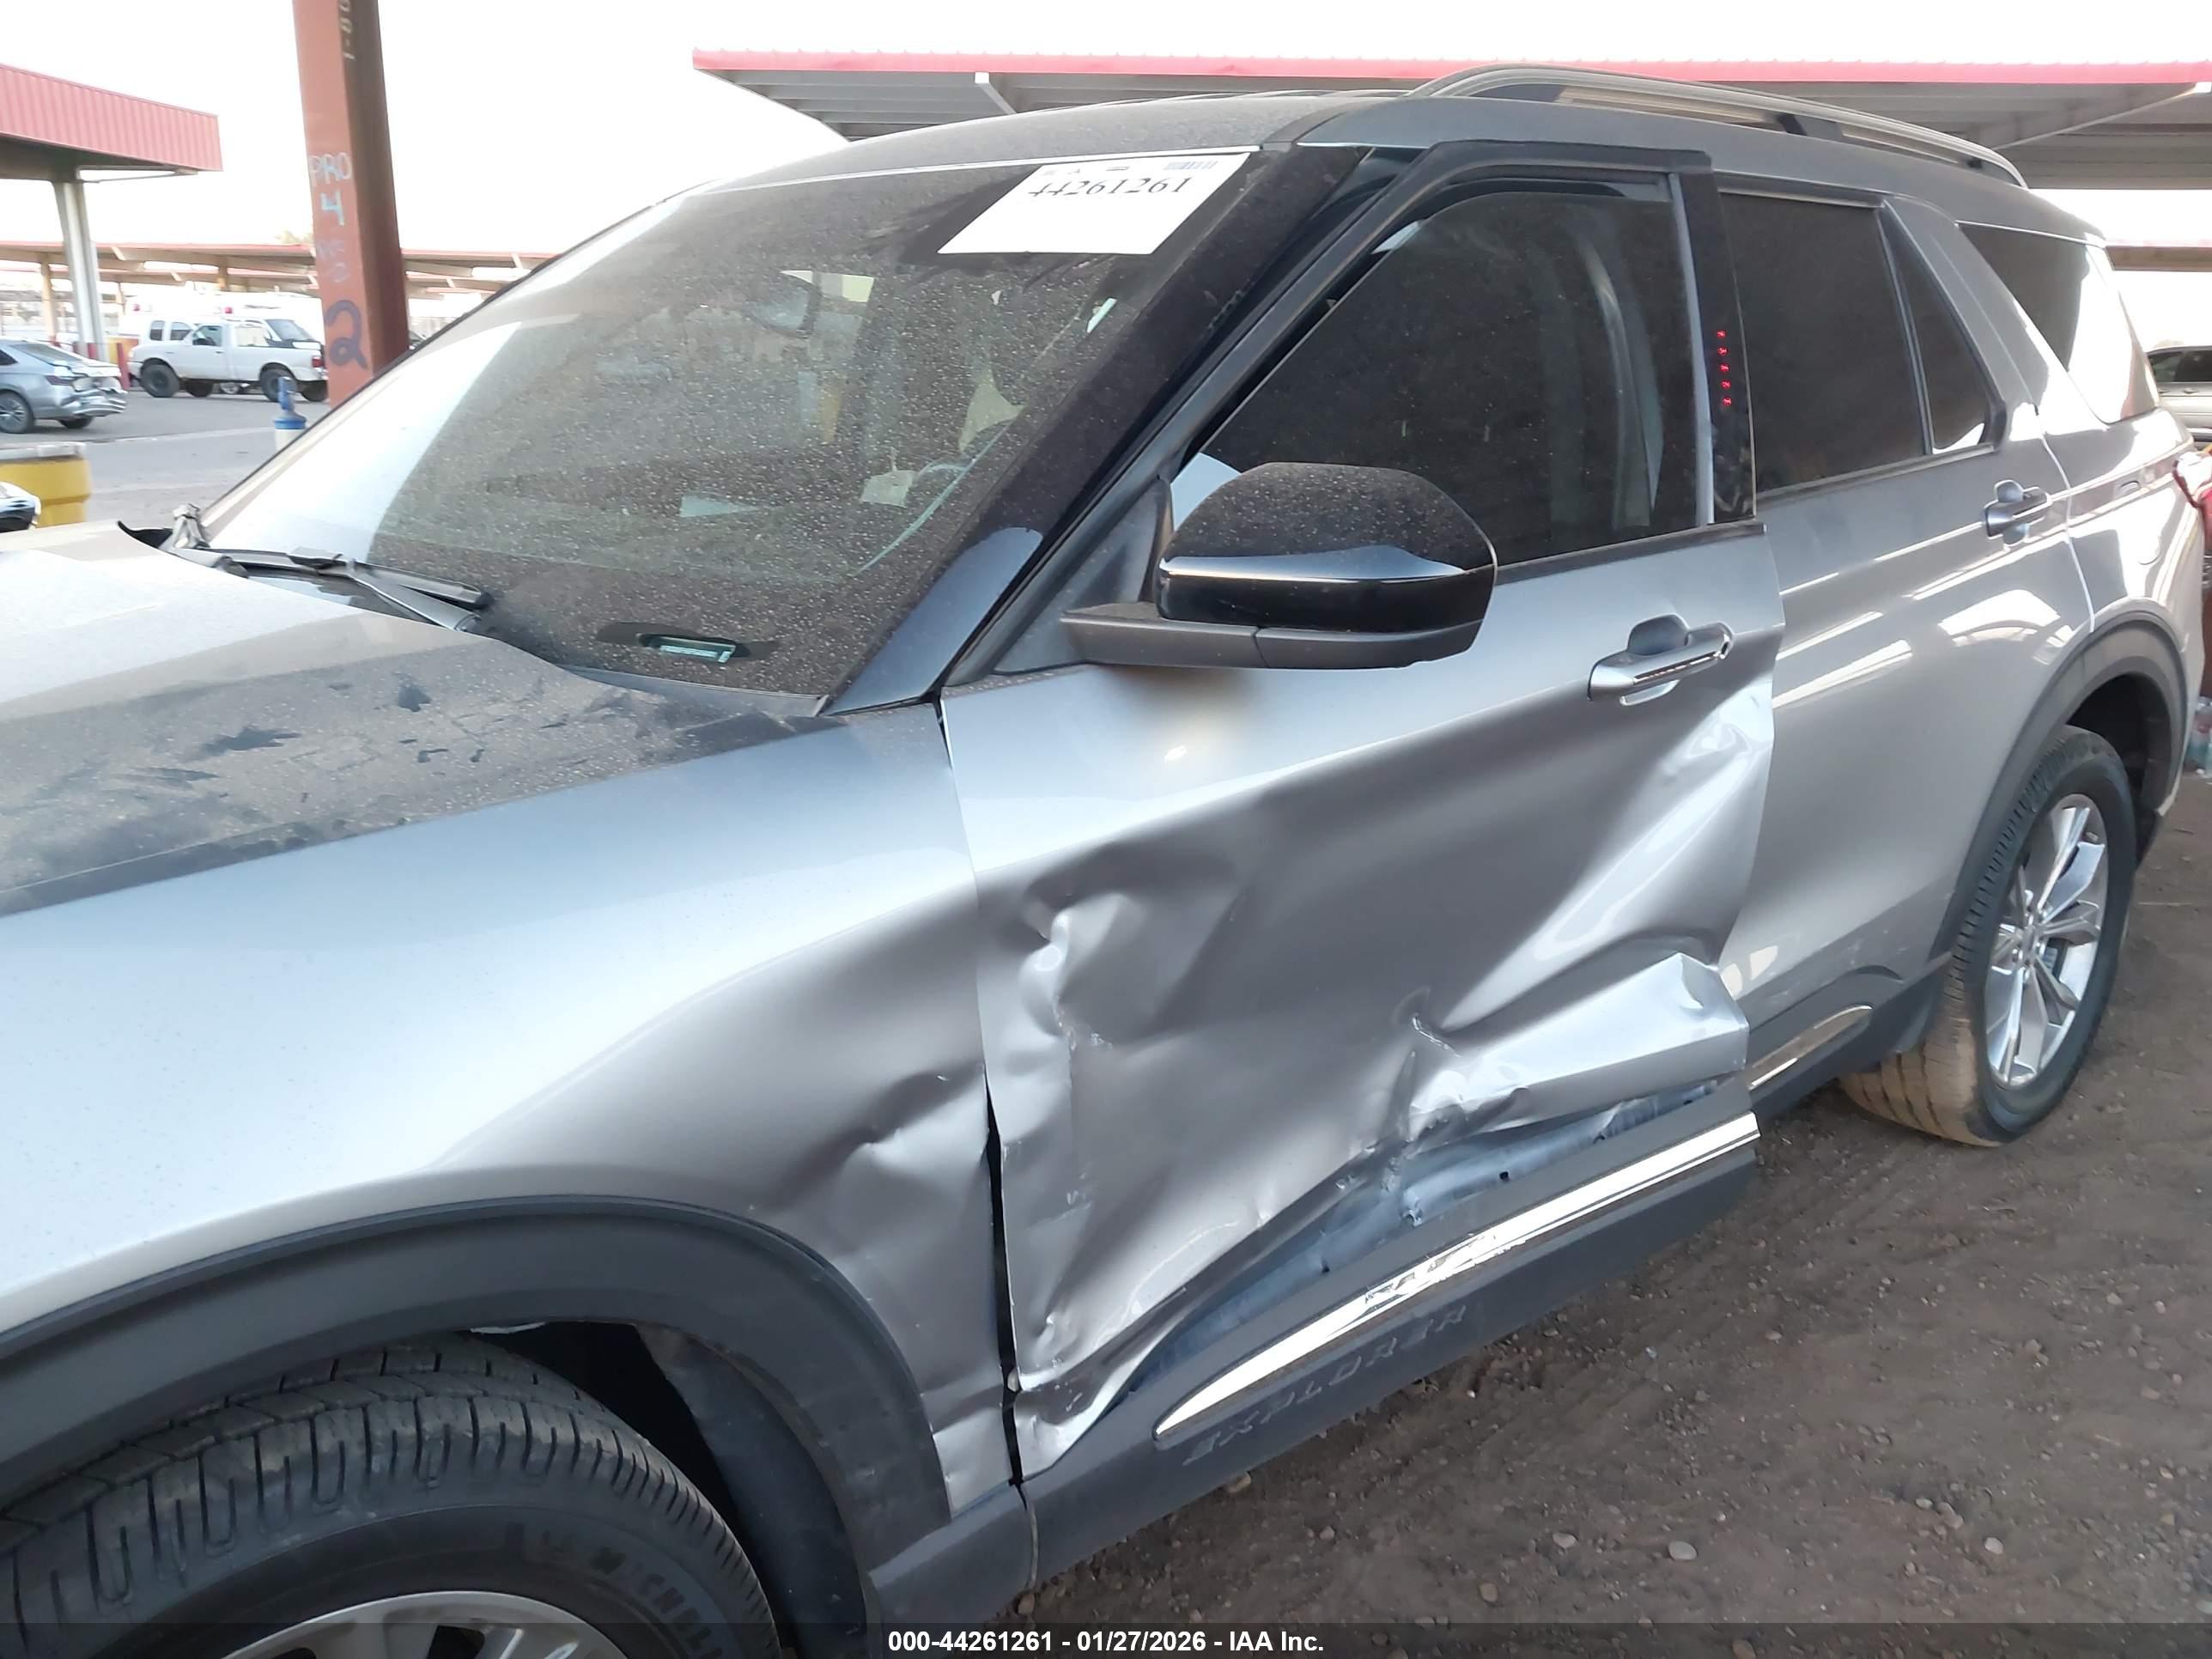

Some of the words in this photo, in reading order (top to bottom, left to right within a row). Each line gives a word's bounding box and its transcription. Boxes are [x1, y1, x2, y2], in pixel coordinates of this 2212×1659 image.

[320, 190, 345, 226] 4
[1029, 177, 1193, 197] 44261261
[324, 300, 369, 369] 2
[1182, 1305, 1467, 1466] EXPLORER
